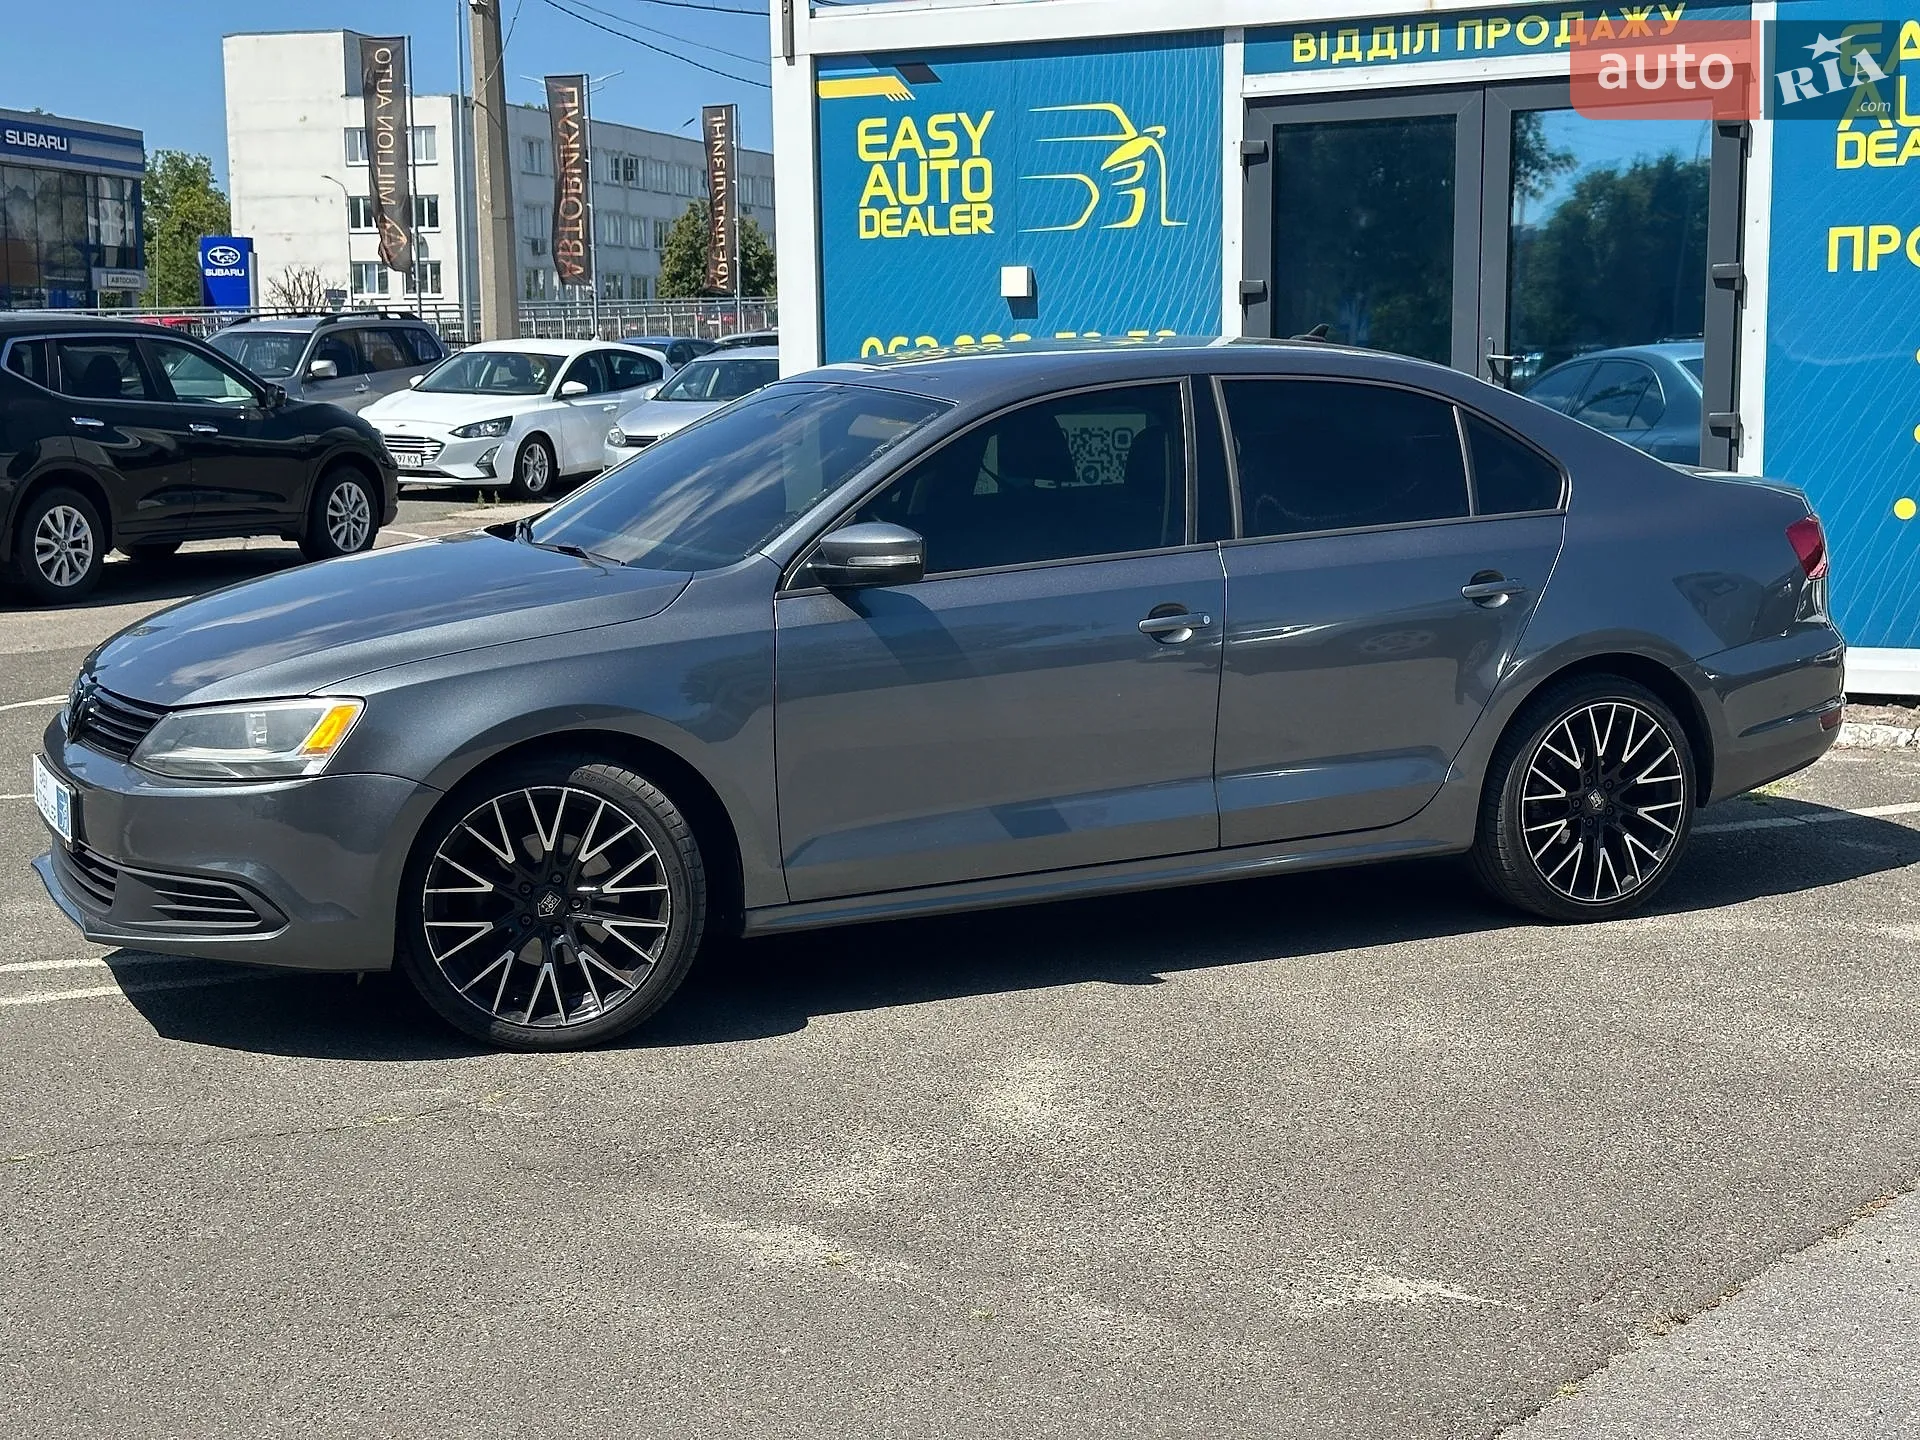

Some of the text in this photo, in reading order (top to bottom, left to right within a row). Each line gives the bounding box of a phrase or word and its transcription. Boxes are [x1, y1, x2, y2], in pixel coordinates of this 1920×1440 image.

[1292, 2, 1687, 64] ВІДДІЛ ПРОДАЖУ
[5, 129, 68, 152] SUBARU
[857, 110, 996, 162] EASY
[858, 157, 994, 208] AUTO
[858, 202, 996, 240] DEALER
[204, 268, 245, 277] SUBARU
